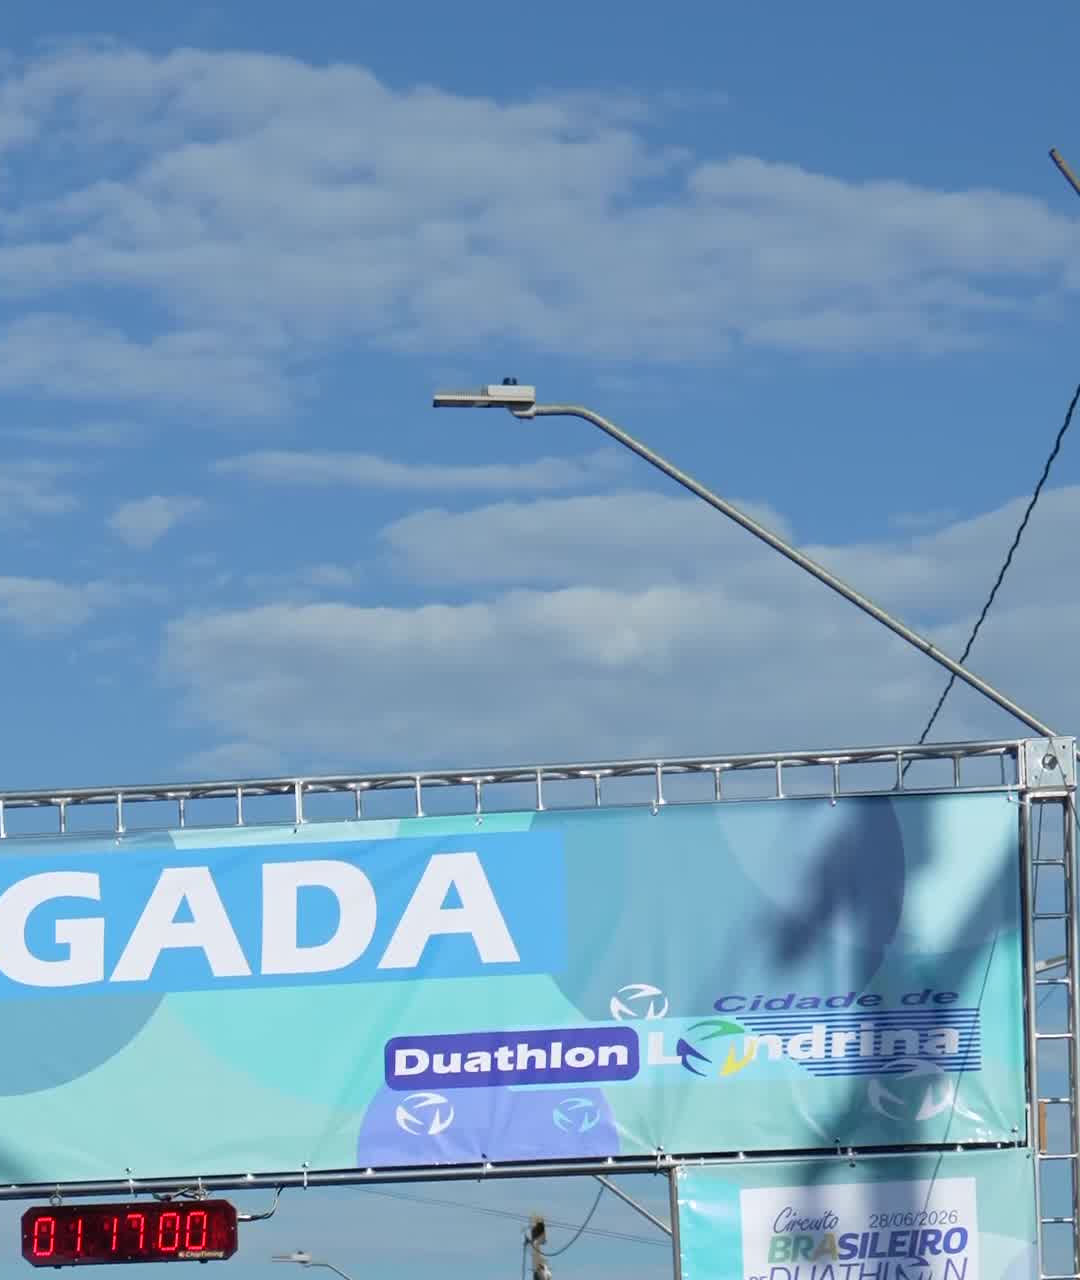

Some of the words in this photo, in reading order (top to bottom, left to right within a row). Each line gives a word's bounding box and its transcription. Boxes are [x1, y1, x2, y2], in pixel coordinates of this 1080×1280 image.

[712, 990, 881, 1014] Cidade
[901, 987, 960, 1007] de
[394, 1039, 628, 1078] Duathlon
[773, 1206, 839, 1234] Circuito
[869, 1210, 958, 1228] 28/06/2026
[768, 1227, 969, 1264] BRASILEIRO
